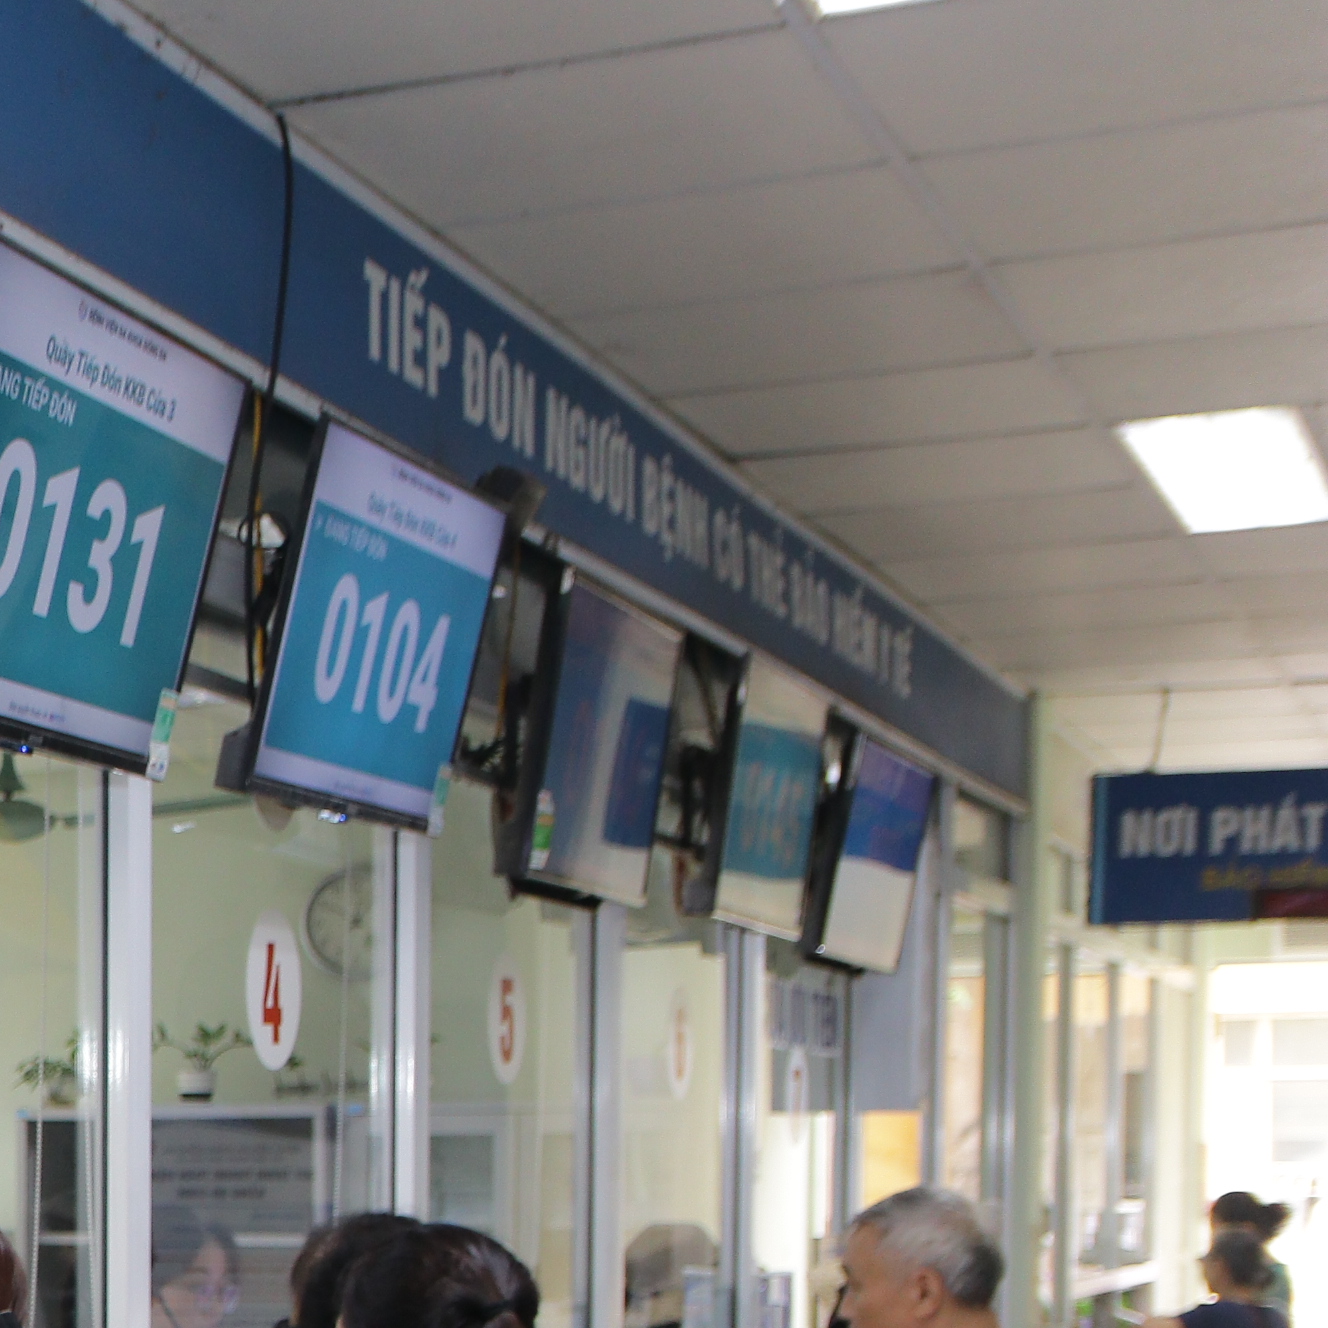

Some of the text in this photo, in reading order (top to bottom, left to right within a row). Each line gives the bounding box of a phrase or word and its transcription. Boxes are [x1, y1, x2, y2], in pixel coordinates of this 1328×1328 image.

[22, 376, 50, 412] TIẾP
[48, 390, 78, 427] ĐÓN
[76, 350, 100, 388] Tiếp
[100, 364, 122, 397] Đón
[363, 256, 451, 399] TIẾP
[462, 328, 536, 459] ĐÓN
[545, 386, 637, 523] NGƯỜI
[315, 573, 450, 733] 0104
[1119, 791, 1328, 858] NƠI PHÁT
[263, 942, 282, 1045] 4
[500, 978, 514, 1065] 5
